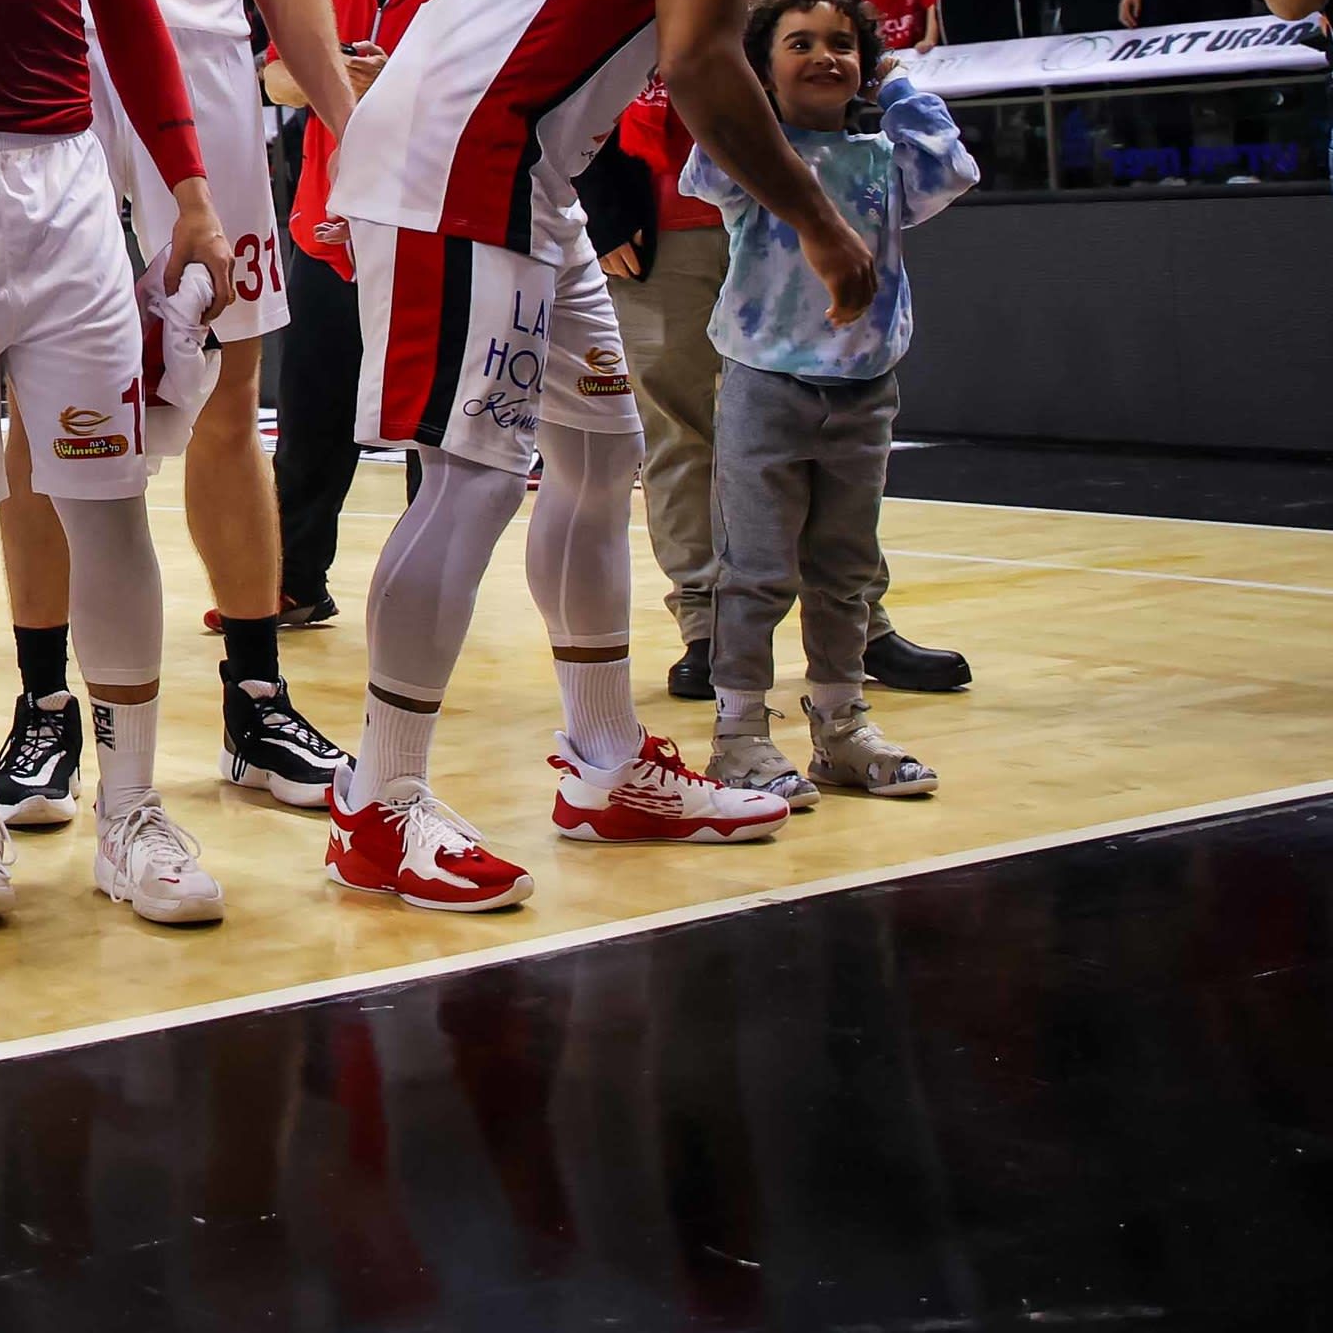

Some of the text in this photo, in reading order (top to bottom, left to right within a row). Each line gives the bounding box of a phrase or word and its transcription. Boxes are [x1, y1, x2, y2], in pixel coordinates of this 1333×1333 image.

[1109, 31, 1211, 61] NEXT
[234, 233, 282, 303] 31
[513, 290, 552, 340] LA
[463, 392, 539, 428] Kinne
[61, 442, 109, 458] Winner
